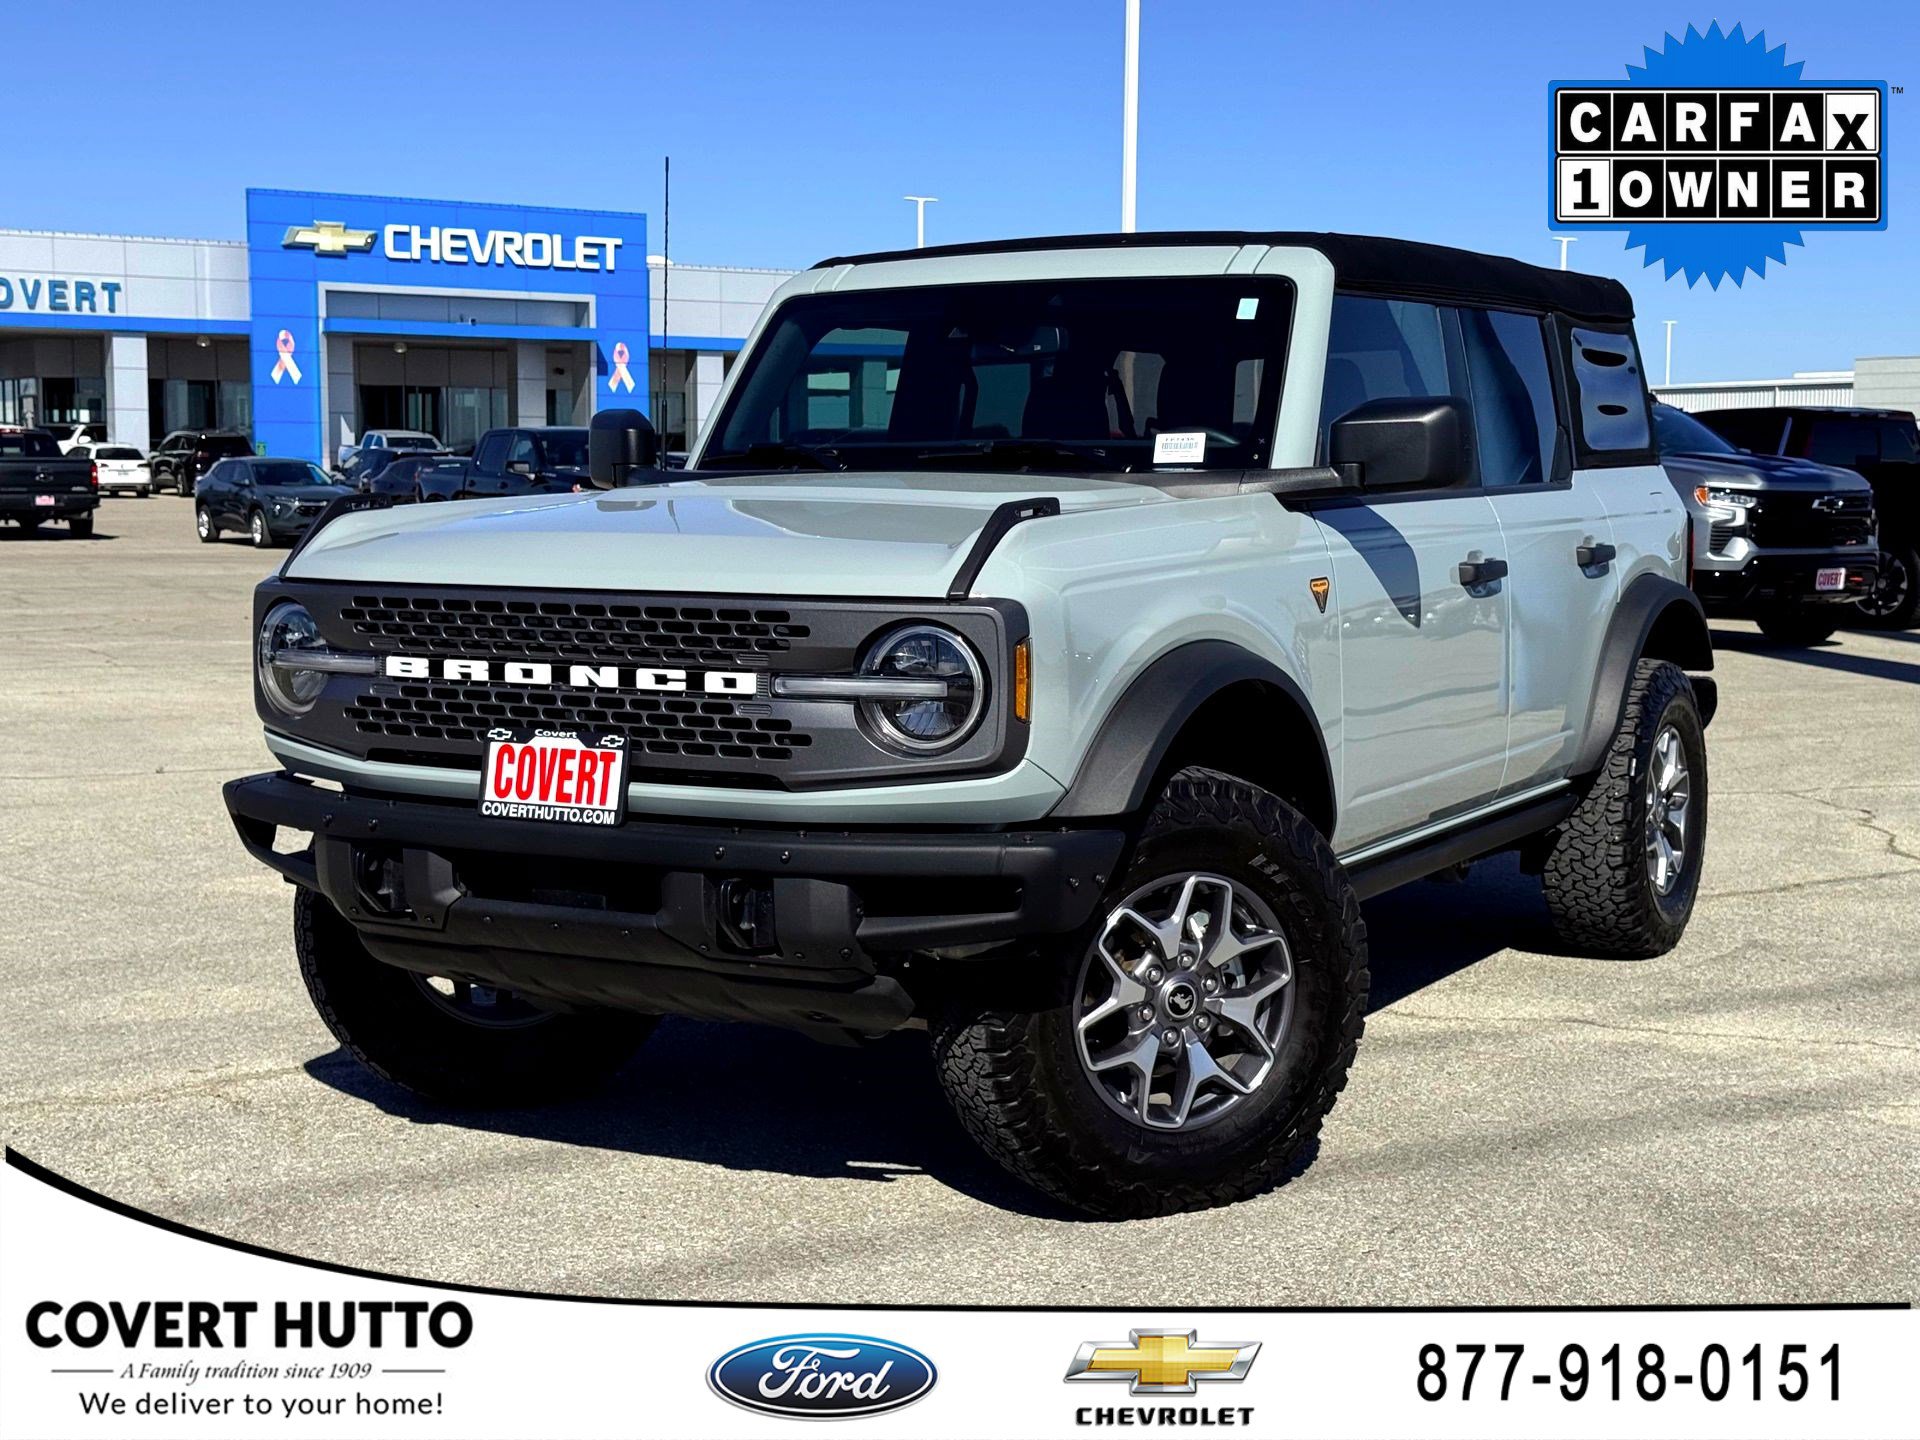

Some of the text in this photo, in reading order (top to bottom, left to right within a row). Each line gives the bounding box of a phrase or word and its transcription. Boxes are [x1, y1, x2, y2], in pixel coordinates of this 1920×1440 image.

[384, 224, 623, 273] CHEVROLET
[385, 655, 758, 695] BRONCO
[534, 728, 578, 739] Covert
[494, 744, 617, 806] COVERT
[481, 801, 616, 825] COVERTHUTTO.COM
